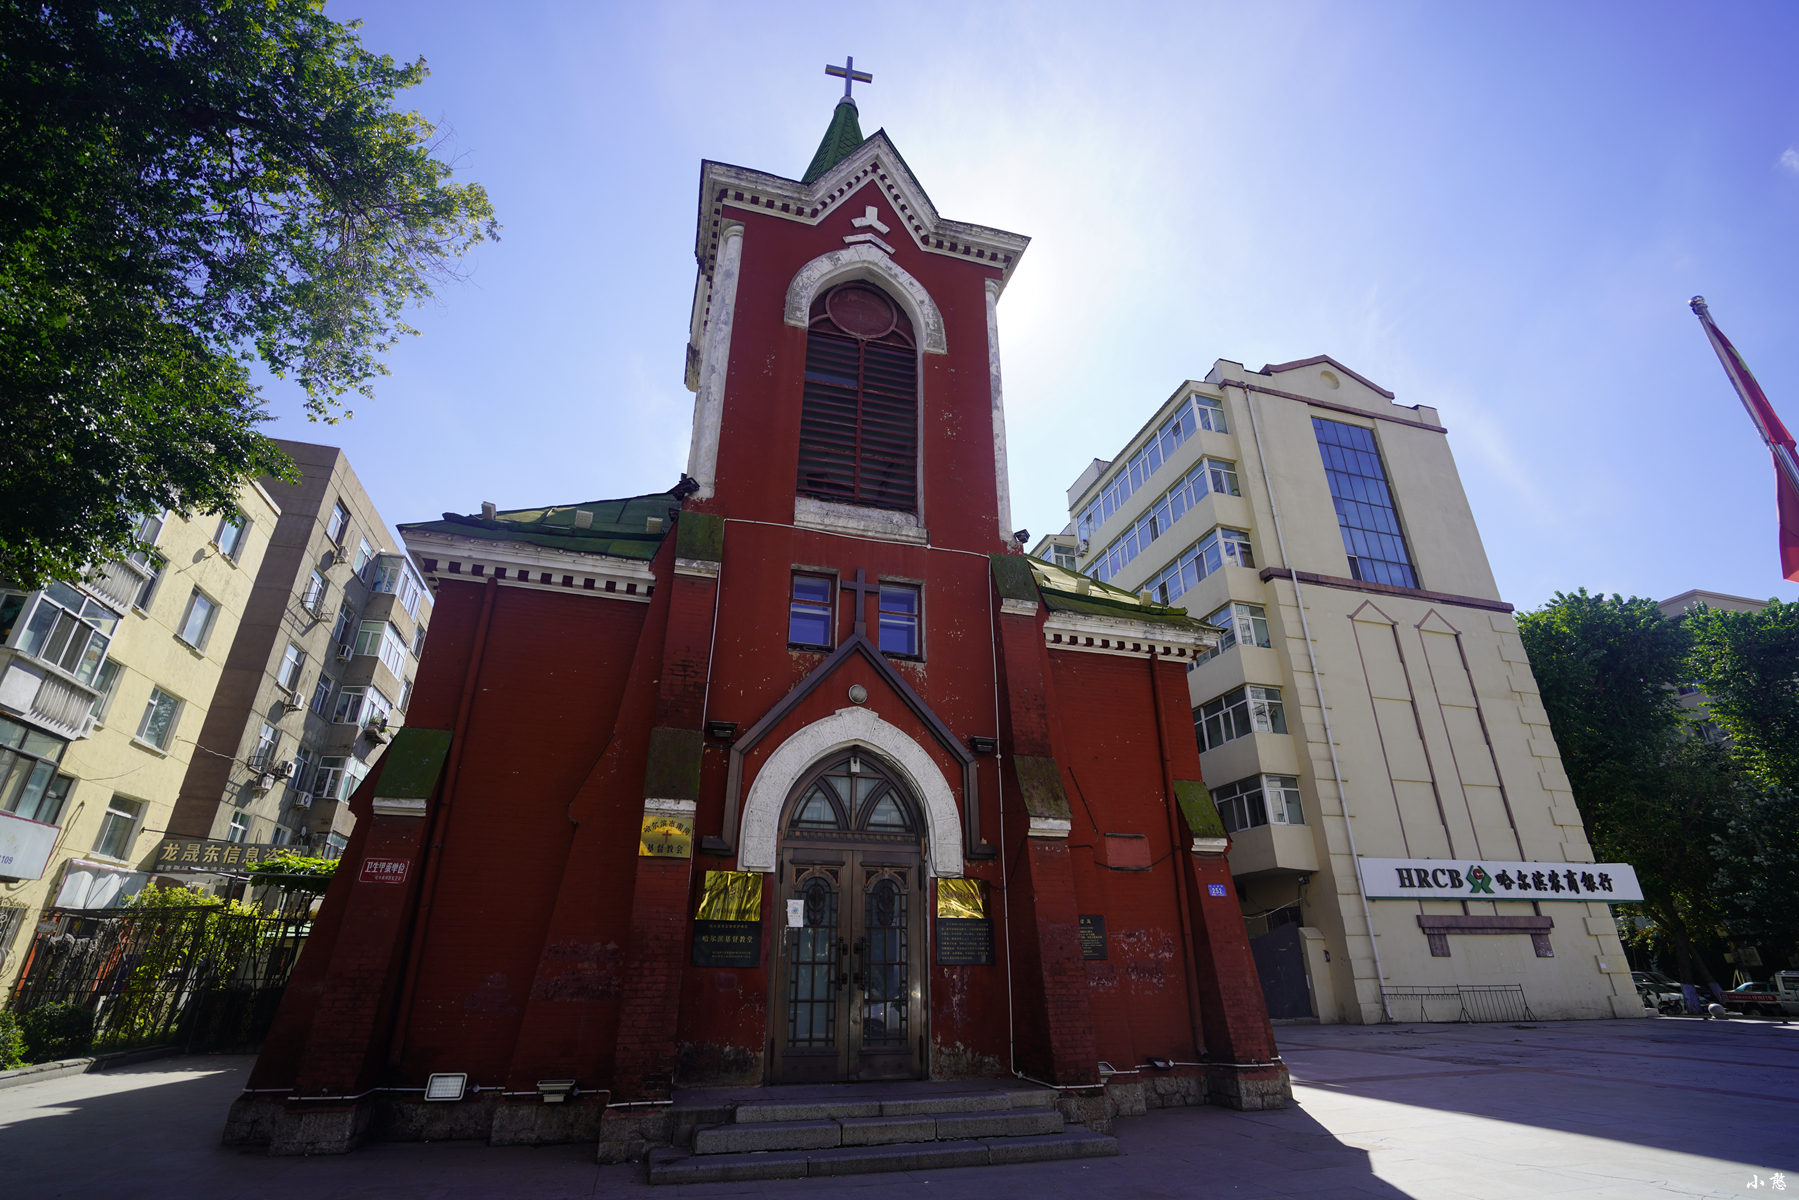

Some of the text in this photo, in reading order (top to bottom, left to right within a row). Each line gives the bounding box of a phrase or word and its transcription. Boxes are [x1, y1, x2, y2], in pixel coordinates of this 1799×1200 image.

[643, 819, 691, 836] 哈尔滨市南岗
[647, 843, 683, 854] 基督教会
[1395, 868, 1464, 889] HRCB
[1495, 869, 1613, 894] 哈尔滨农商银行
[702, 935, 753, 943] 哈尔滨基督教堂
